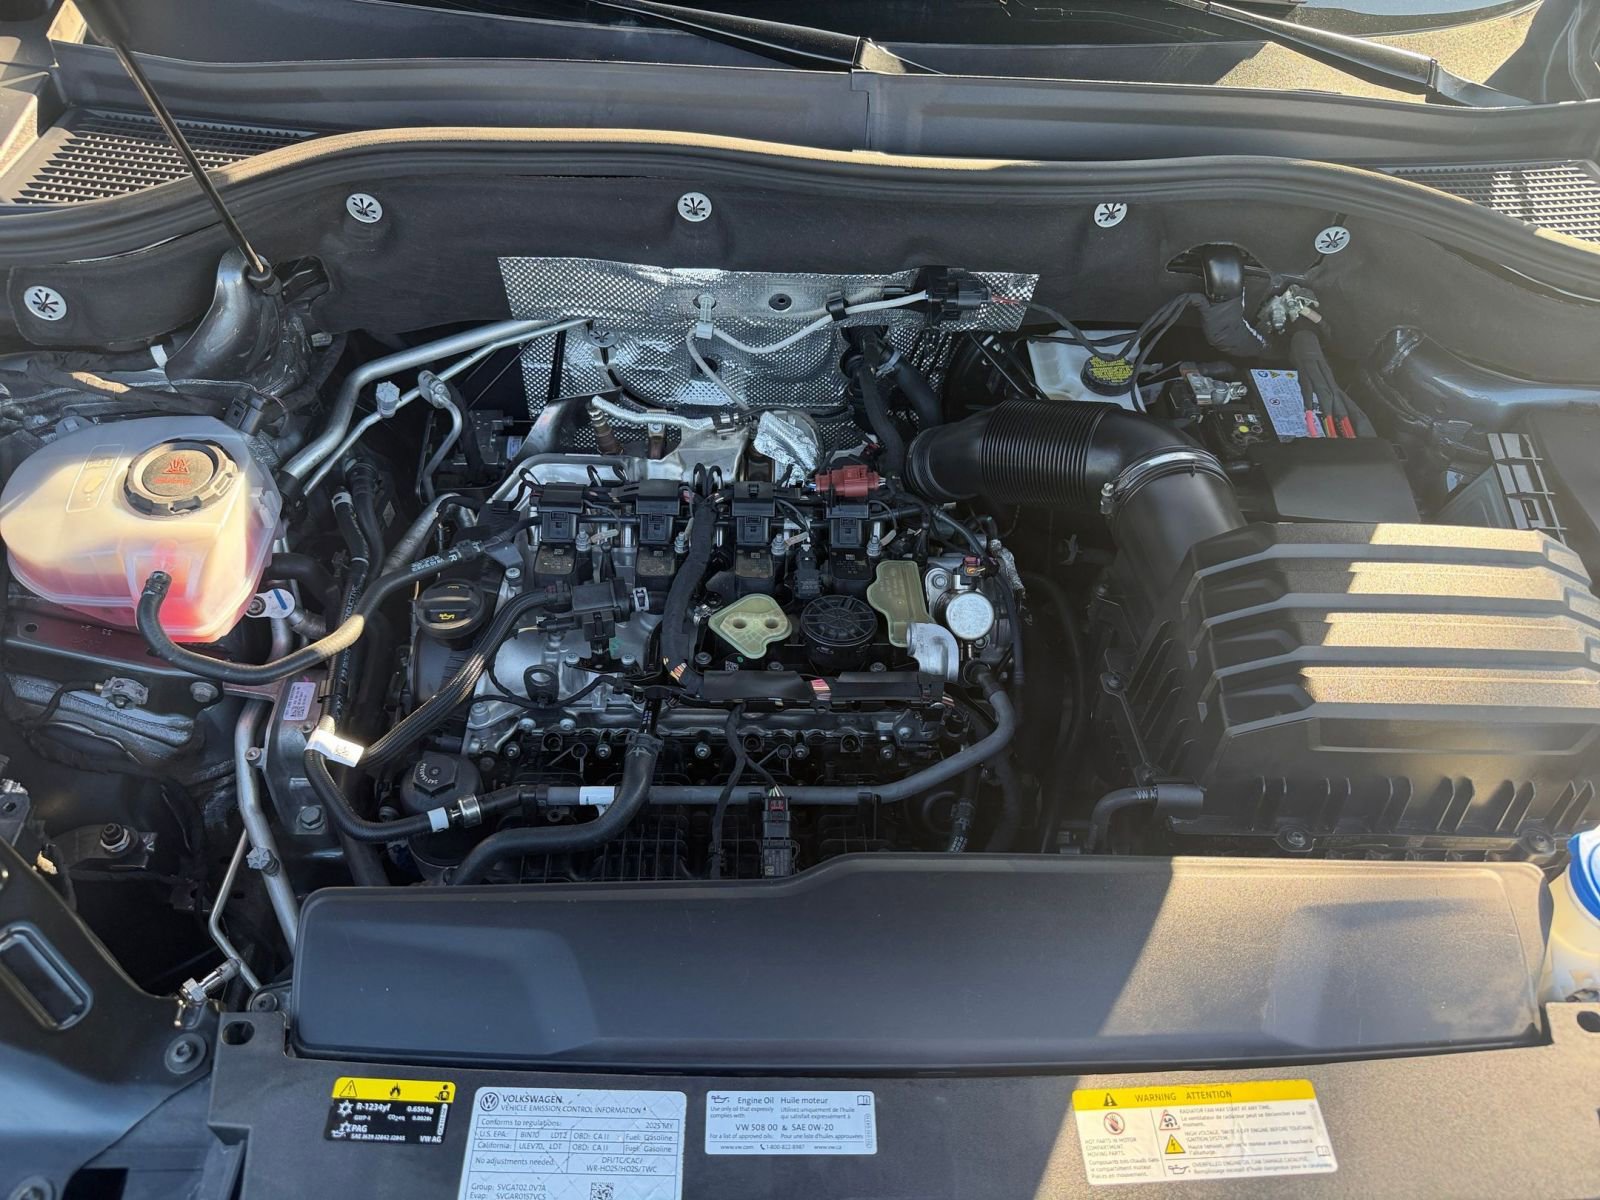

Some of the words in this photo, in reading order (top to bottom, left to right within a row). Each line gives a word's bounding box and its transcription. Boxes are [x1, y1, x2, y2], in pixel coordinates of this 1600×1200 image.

[502, 1094, 563, 1104] VOLKSWAGEN
[1134, 1093, 1176, 1102] WARNING
[1186, 1090, 1232, 1100] ATTENTION
[738, 1097, 762, 1105] Engine
[351, 1124, 368, 1132] PAG
[471, 1183, 494, 1192] Group:
